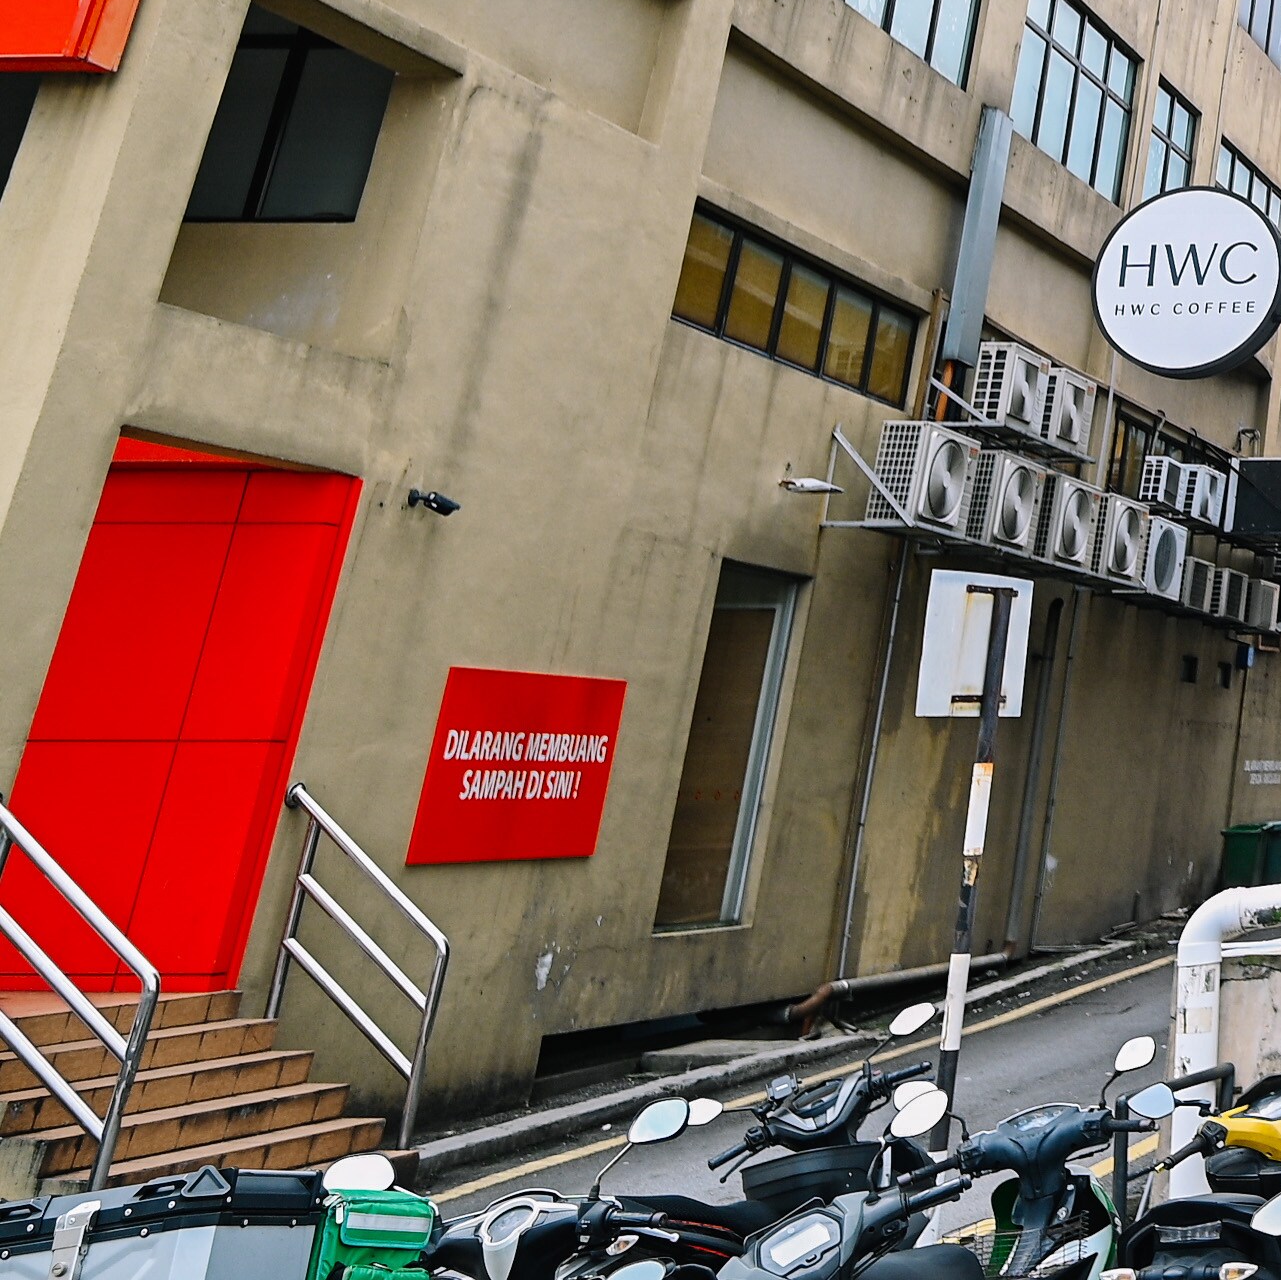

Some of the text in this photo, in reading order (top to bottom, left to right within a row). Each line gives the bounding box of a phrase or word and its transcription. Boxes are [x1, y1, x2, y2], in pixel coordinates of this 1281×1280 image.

[1118, 241, 1258, 287] HWC
[1114, 301, 1255, 316] HWC COFFEE
[443, 729, 608, 763] DILARANG MEMBUANG
[459, 769, 527, 800] SAMPAH
[526, 770, 545, 800] DI
